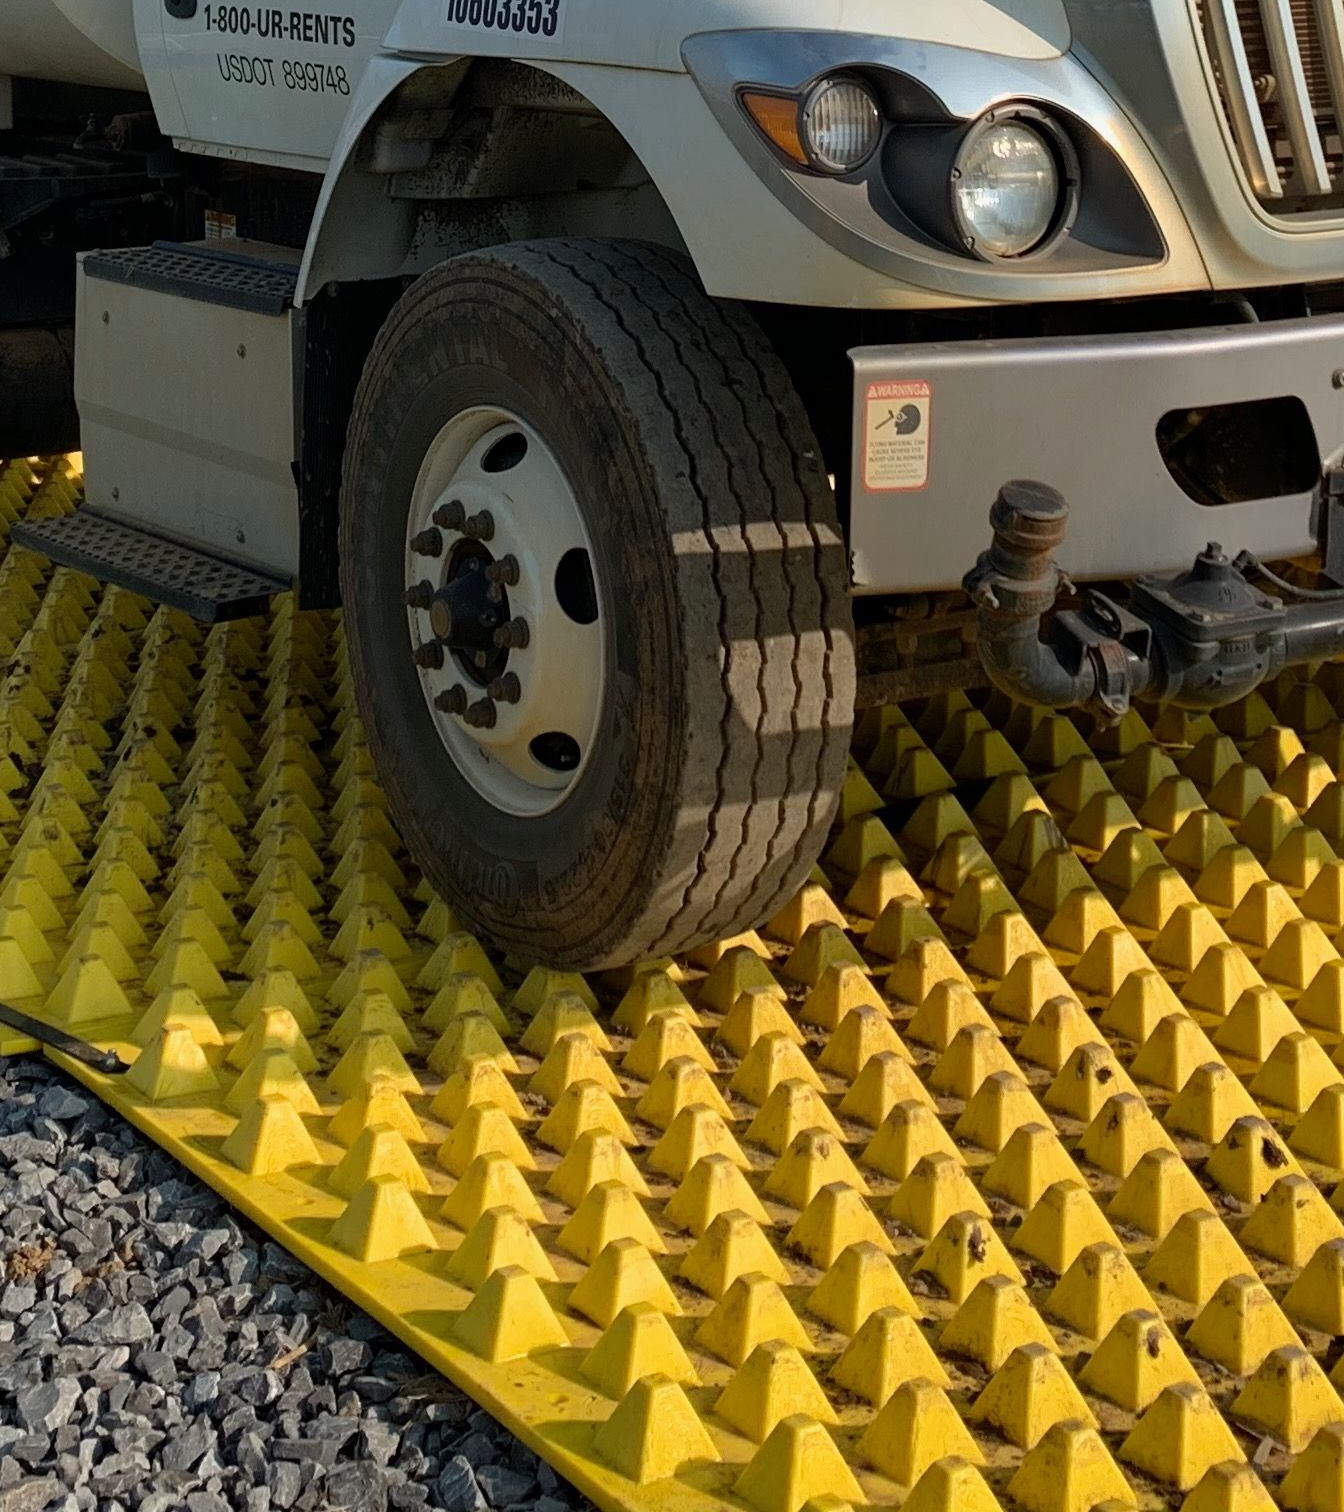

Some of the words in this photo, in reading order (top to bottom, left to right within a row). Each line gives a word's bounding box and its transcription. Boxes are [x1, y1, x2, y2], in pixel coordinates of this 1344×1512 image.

[204, 4, 356, 48] 1-800-UR-RENTS
[217, 53, 275, 87] USDOT
[282, 59, 351, 96] 899748
